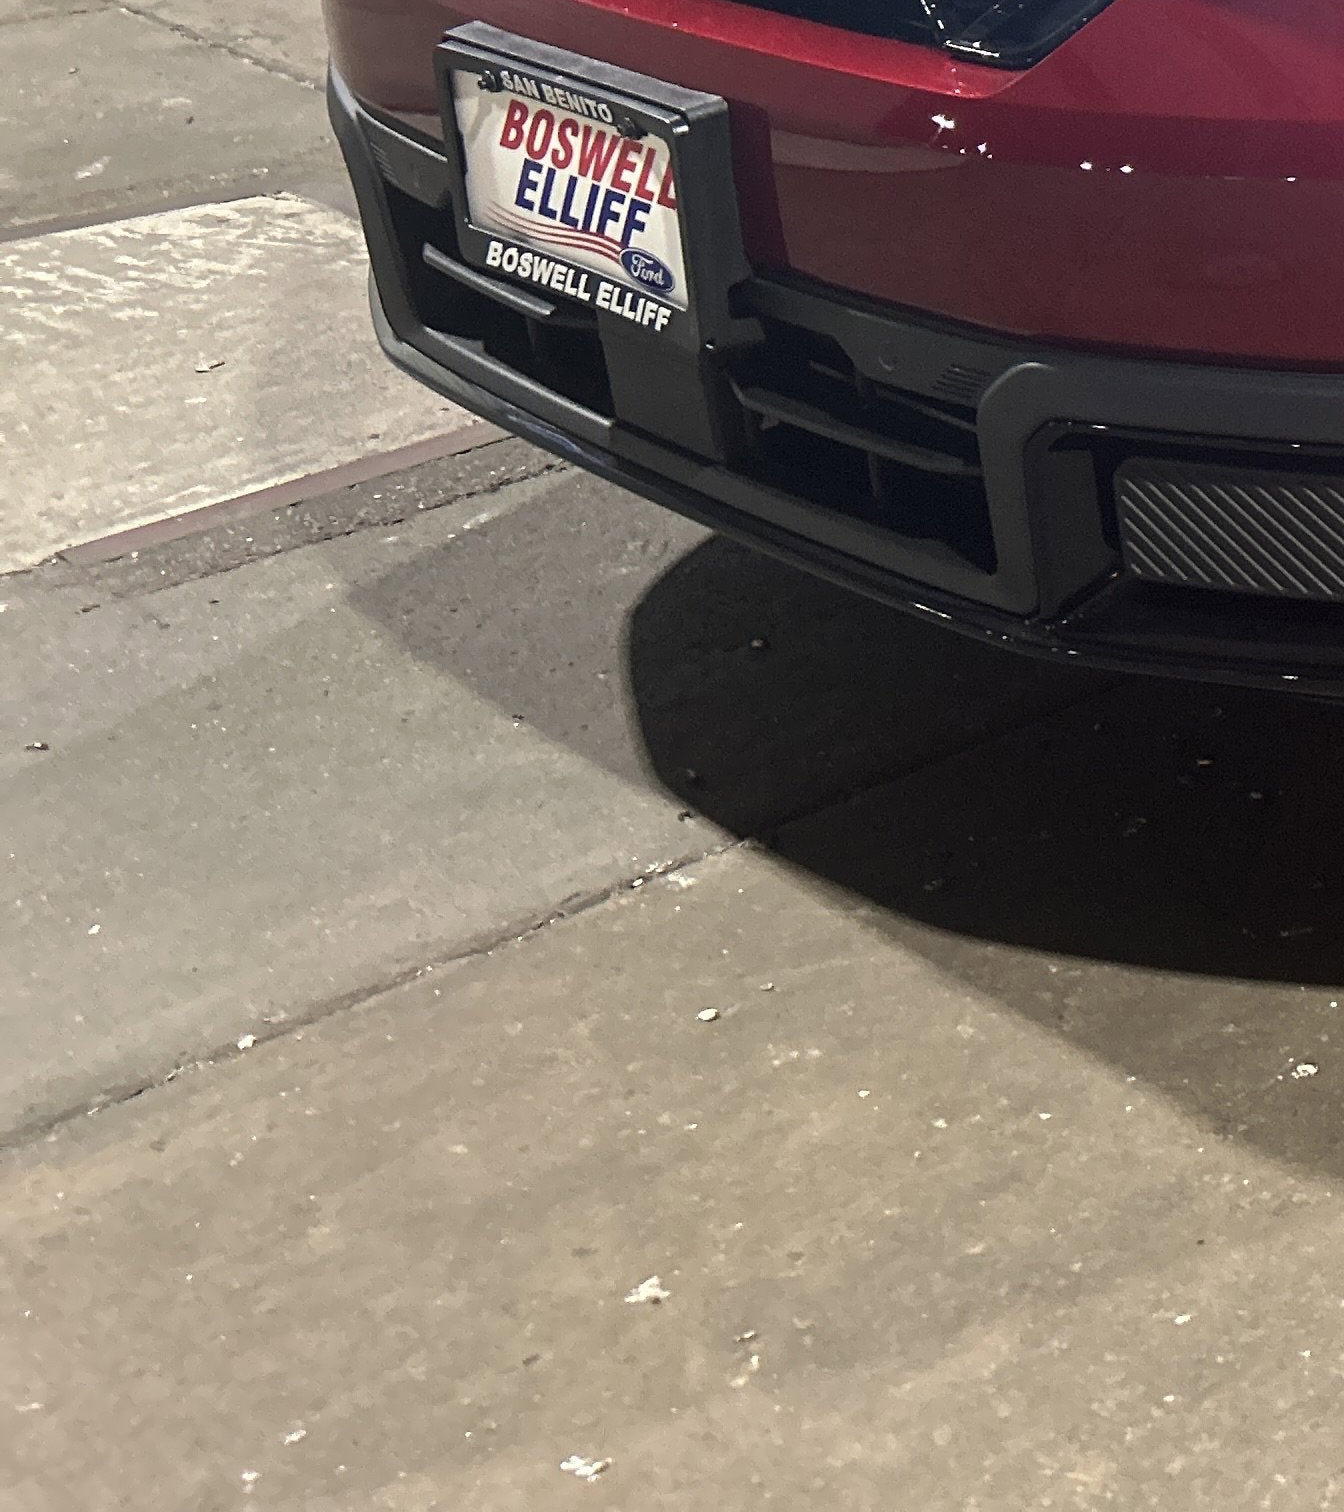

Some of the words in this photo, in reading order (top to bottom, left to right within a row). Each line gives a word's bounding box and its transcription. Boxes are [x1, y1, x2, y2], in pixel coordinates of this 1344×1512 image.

[500, 70, 539, 99] SAN
[544, 82, 613, 123] BENITO
[499, 99, 678, 211] BOSWELL
[515, 158, 651, 248] ELLIFF
[486, 241, 592, 302] BOSWELL
[596, 282, 672, 332] ELLIFF
[631, 253, 664, 285] Ford
